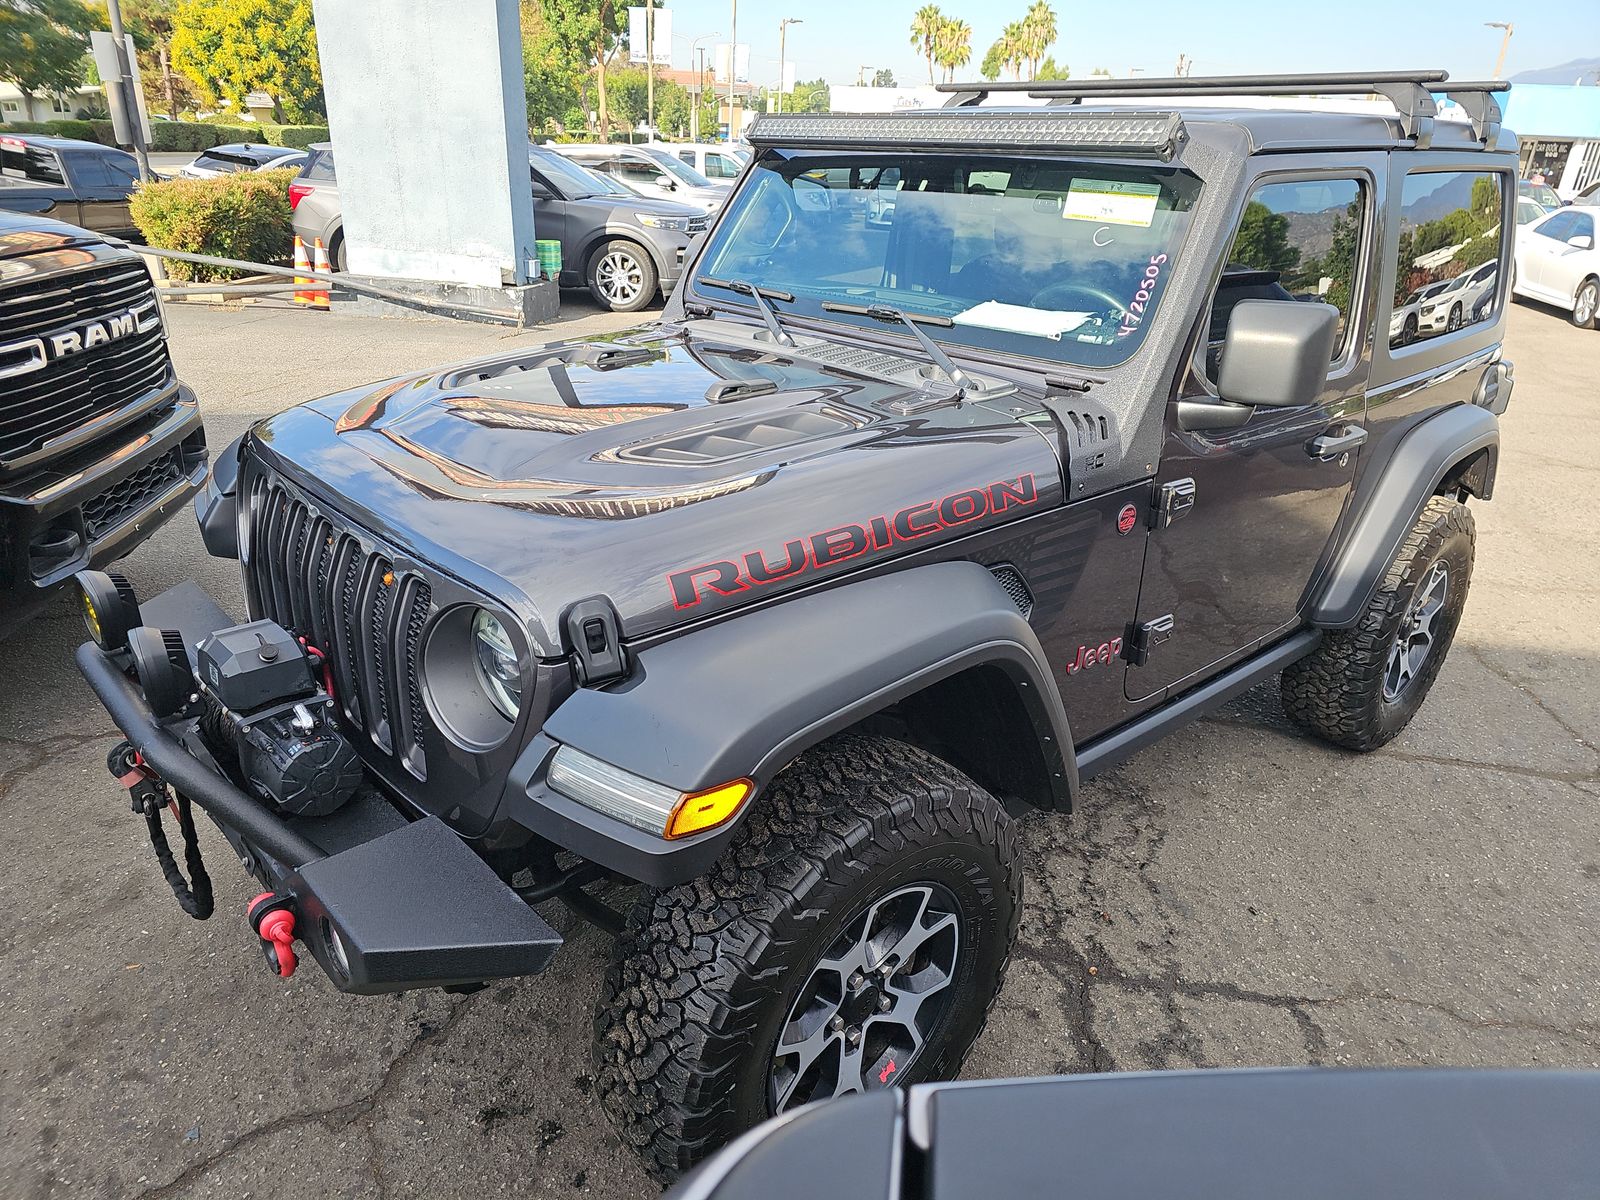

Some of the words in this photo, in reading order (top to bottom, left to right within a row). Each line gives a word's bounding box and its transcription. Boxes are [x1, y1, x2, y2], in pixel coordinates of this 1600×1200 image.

[1117, 253, 1168, 337] 4720505
[50, 312, 135, 358] RAM
[666, 472, 1039, 611] RUBICON
[1066, 635, 1124, 676] Jeep
